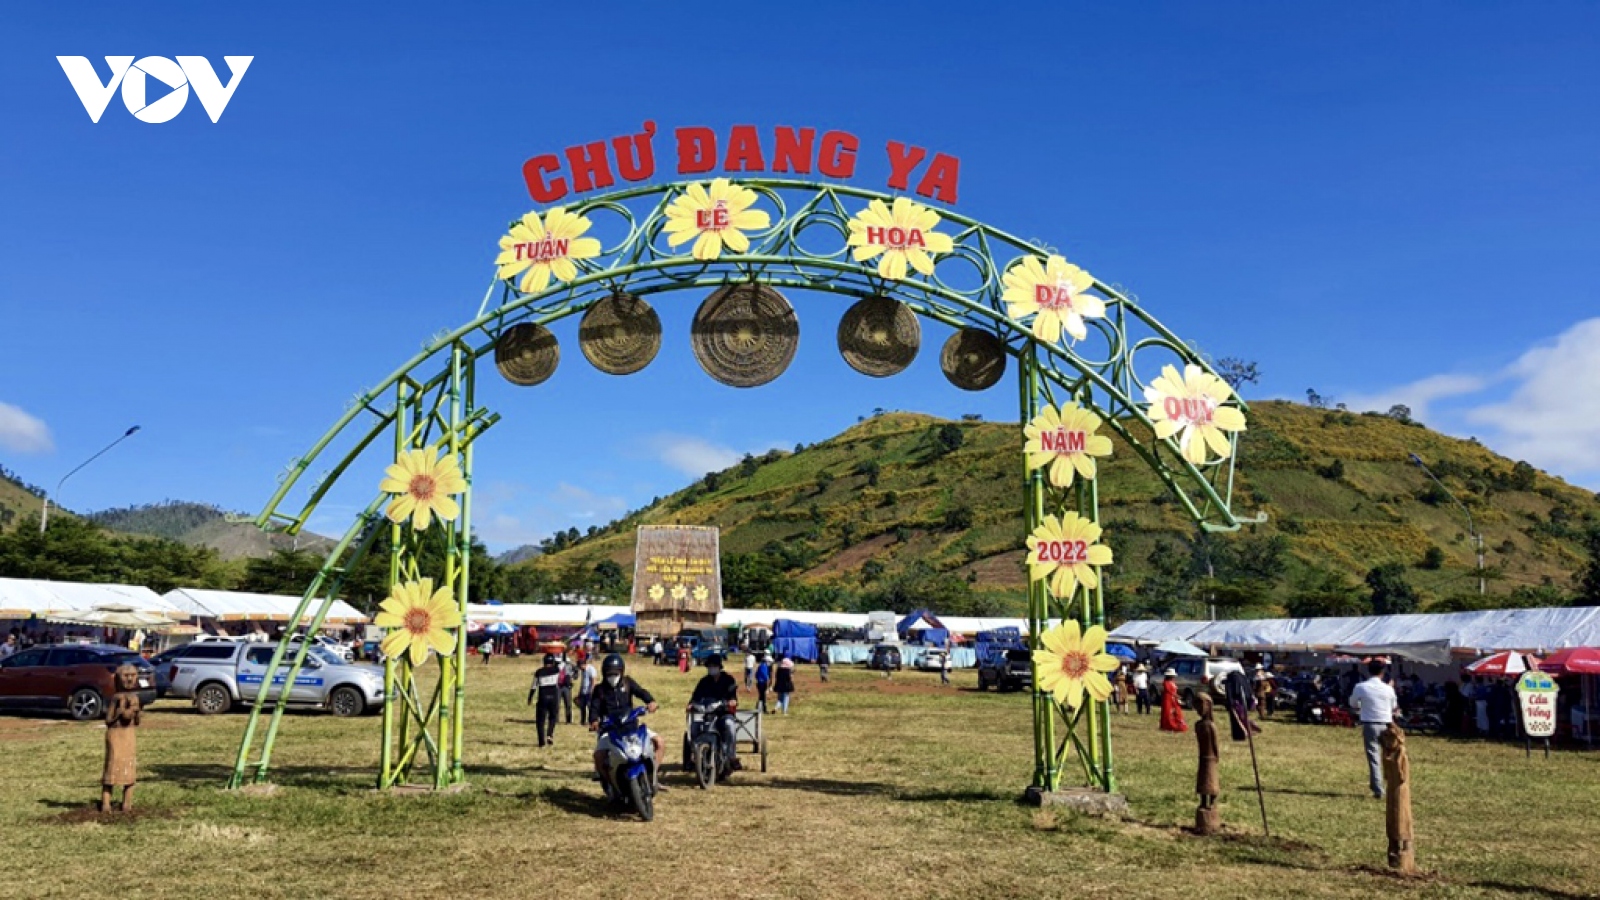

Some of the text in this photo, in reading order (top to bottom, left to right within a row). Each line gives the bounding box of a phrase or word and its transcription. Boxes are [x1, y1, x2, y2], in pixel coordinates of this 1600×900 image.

[521, 121, 961, 204] CHƯ ĐANG YA
[696, 200, 729, 228] LỄ
[866, 227, 926, 248] HOA
[1041, 428, 1085, 451] NĂM
[1037, 540, 1087, 562] 2022
